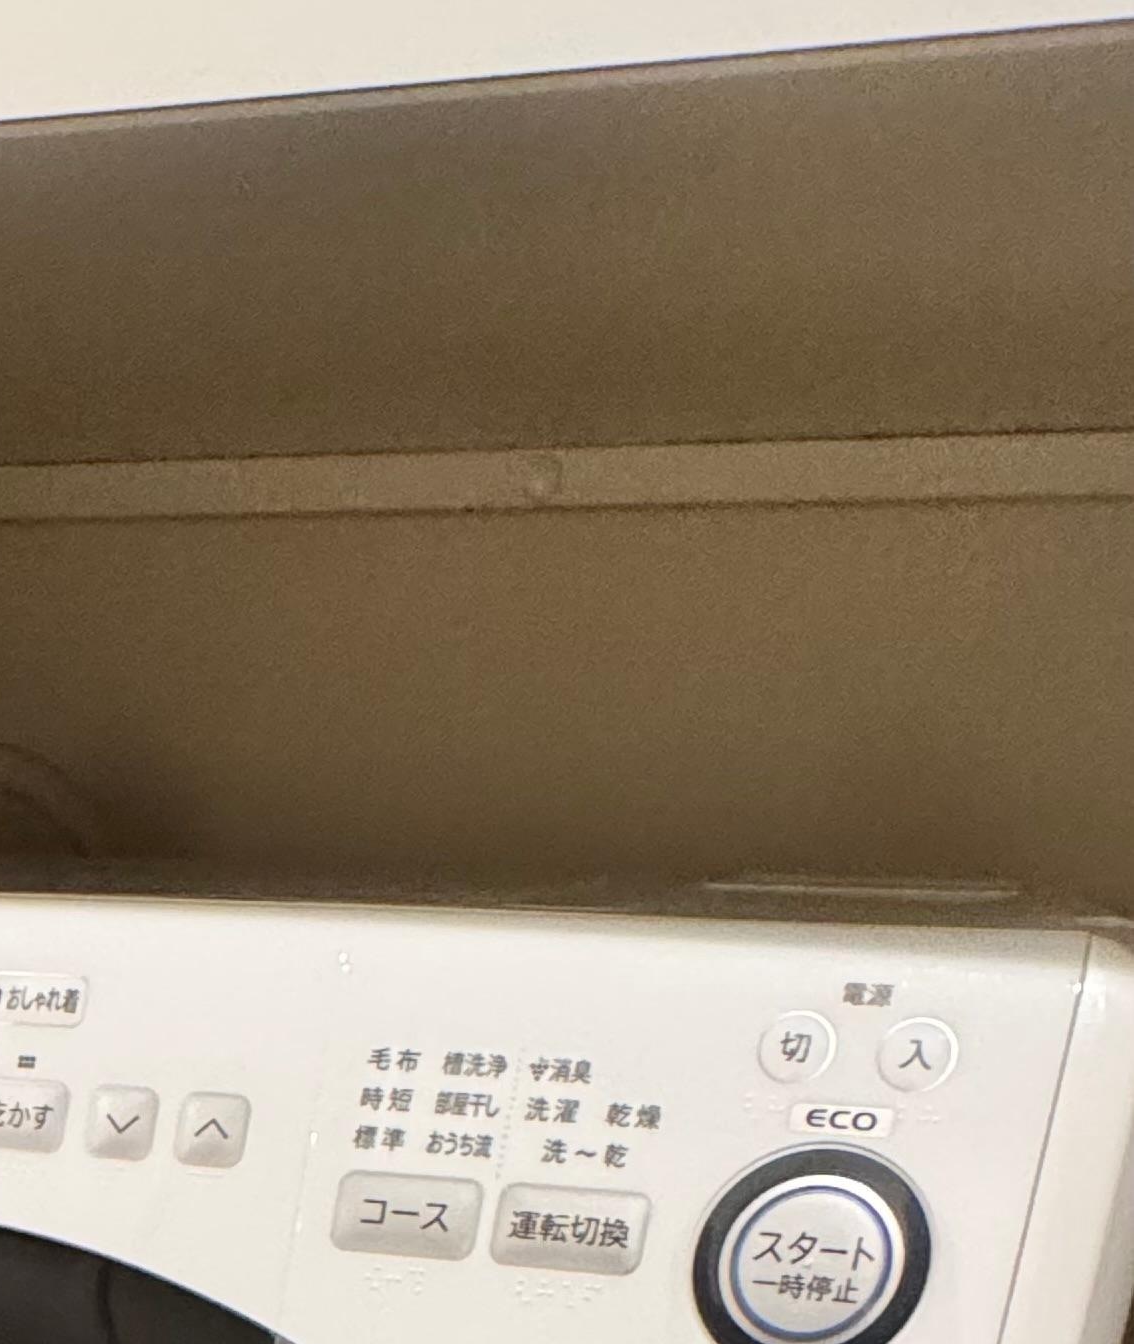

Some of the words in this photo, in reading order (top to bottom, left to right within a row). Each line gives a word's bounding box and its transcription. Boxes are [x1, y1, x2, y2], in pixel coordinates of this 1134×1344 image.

[843, 982, 895, 1007] 電源
[367, 1047, 421, 1072] 毛布
[781, 1031, 812, 1063] 切
[898, 1039, 932, 1070] 入
[442, 1052, 507, 1079] 槽洗浄
[550, 1059, 592, 1083] 消臭
[360, 1087, 413, 1112] 時短
[434, 1090, 500, 1118] 部屋干し
[525, 1097, 579, 1123] 洗濯
[605, 1102, 662, 1130] 乾燥
[805, 1108, 878, 1132] ECO
[353, 1125, 406, 1151] 標準
[360, 1198, 449, 1232] コース
[507, 1210, 630, 1248] 運転切換
[752, 1232, 875, 1271] スタート
[752, 1273, 859, 1304] 一時停止
